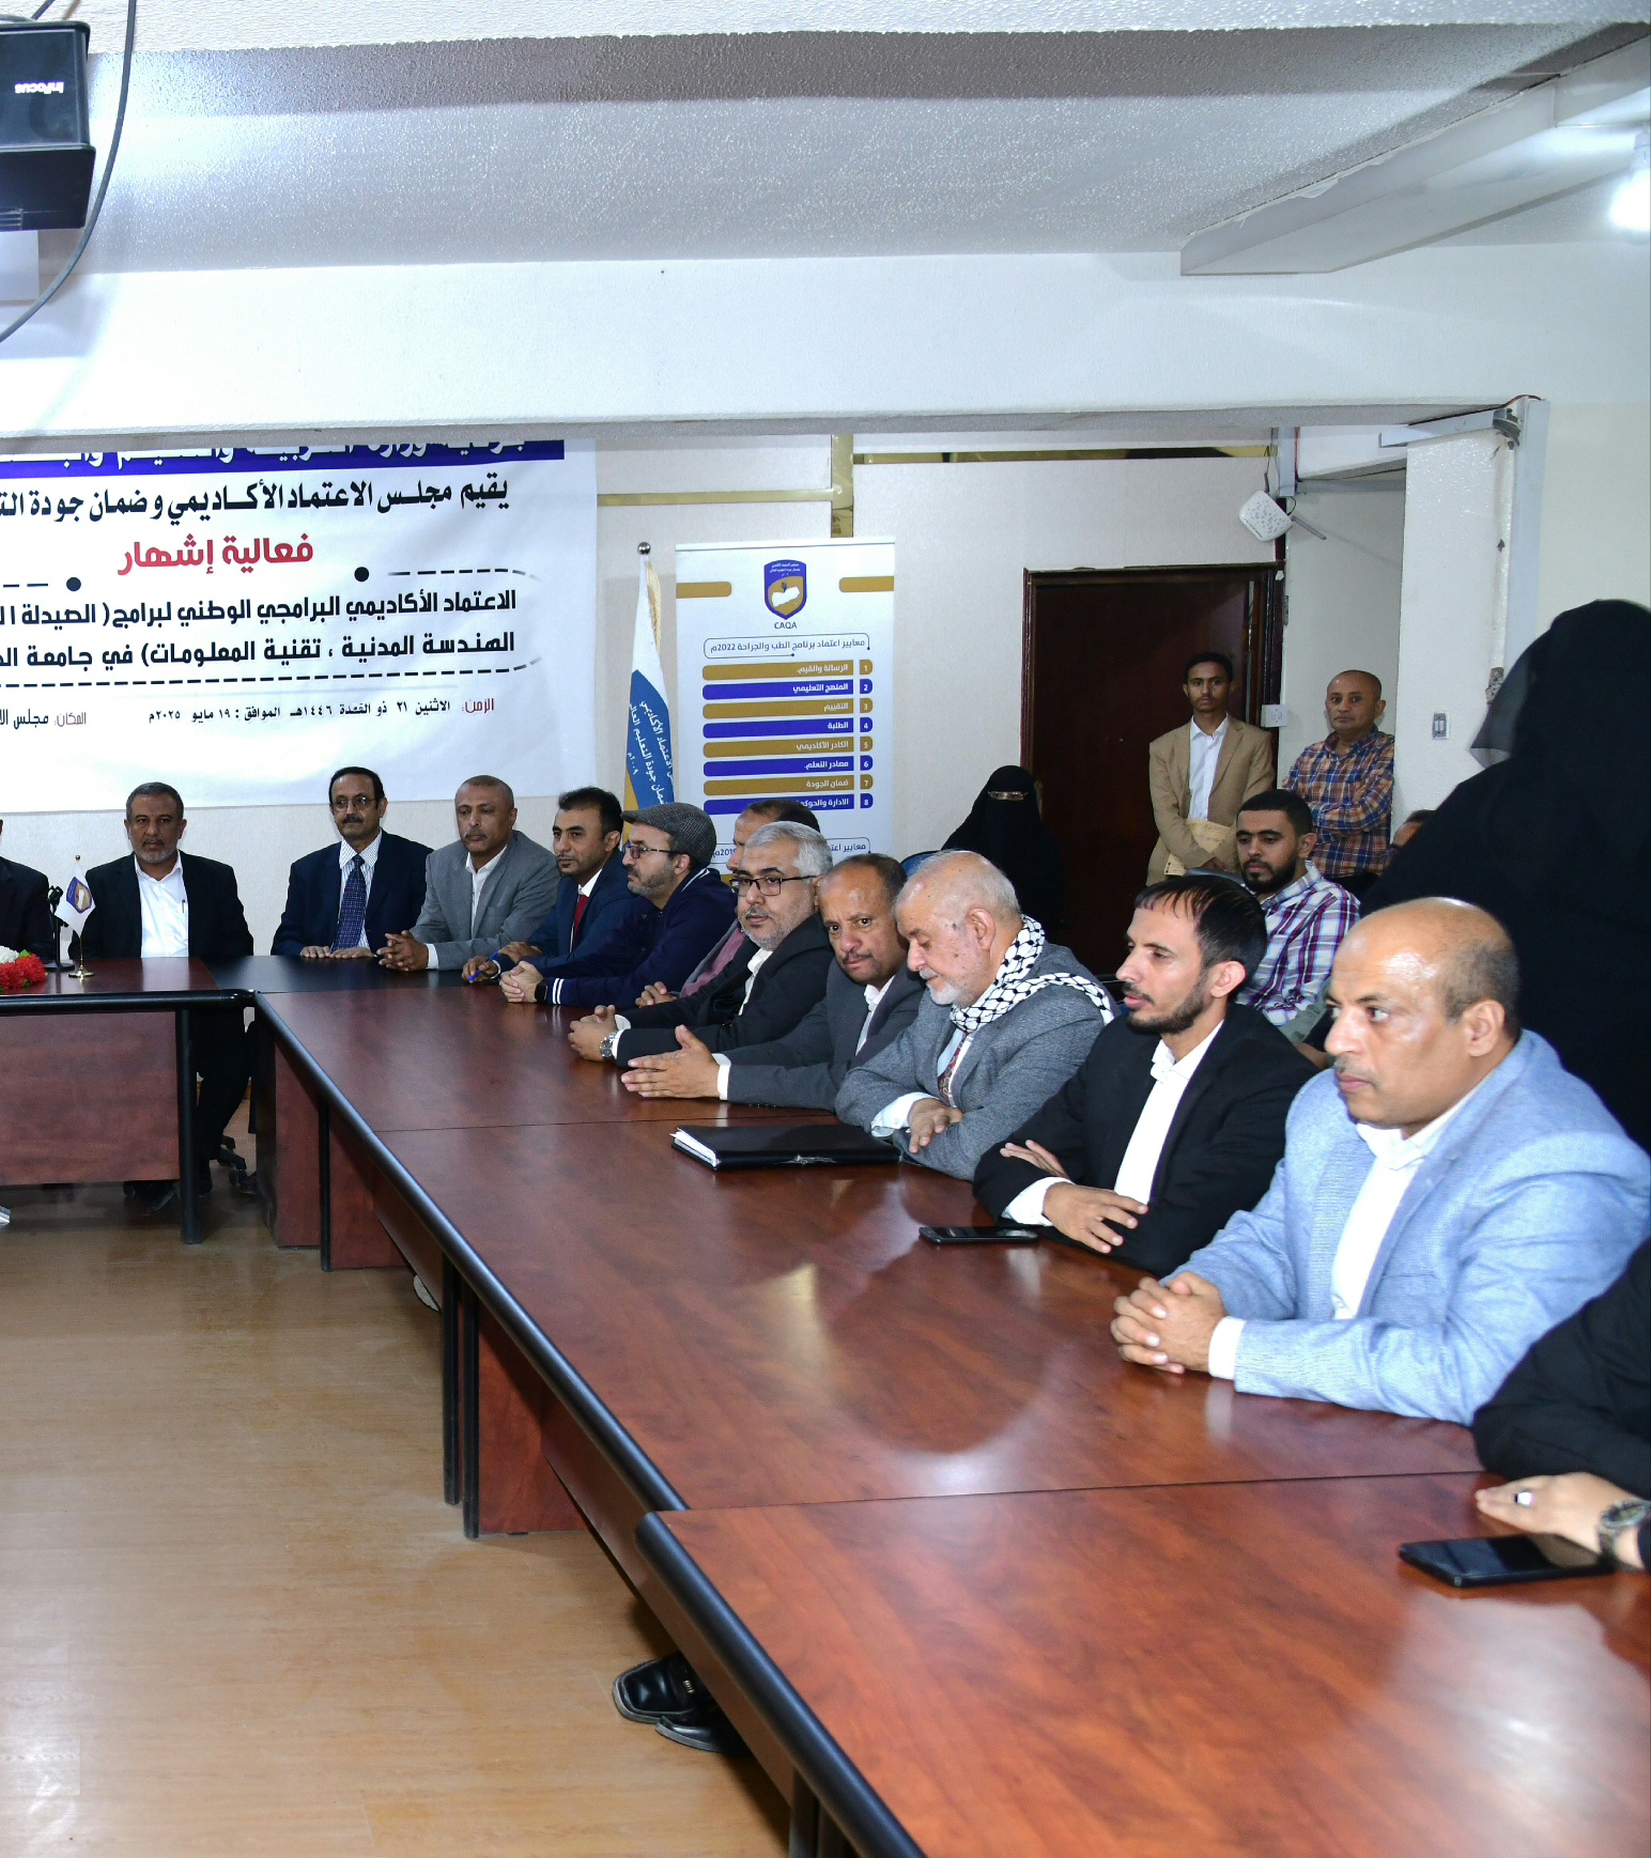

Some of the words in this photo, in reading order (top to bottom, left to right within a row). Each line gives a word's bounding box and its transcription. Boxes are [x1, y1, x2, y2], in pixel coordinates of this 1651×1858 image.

[14, 81, 64, 94] InFocus
[287, 480, 373, 510] الاعتماد
[377, 479, 453, 514] مجلس
[460, 472, 510, 510] يقيم
[29, 489, 84, 523] جودة
[167, 477, 284, 527] الأكاديمي
[117, 532, 214, 576] إشهار
[221, 532, 314, 574] فعالية
[257, 594, 341, 625] البرامجي
[345, 588, 438, 622] الأكاديمي
[443, 589, 517, 613] الاعتماد
[21, 602, 97, 631] الصيدلة
[177, 597, 251, 628] الوطني
[774, 621, 798, 630] CAQA
[341, 634, 415, 664] المدنية
[422, 631, 515, 654] الهندسة
[737, 642, 770, 652] والجراحة
[771, 641, 791, 650] الطب
[791, 640, 816, 651] برنامج
[817, 639, 840, 648] اعتماد
[842, 638, 866, 649] معايير
[26, 644, 93, 672] جامعة
[102, 643, 134, 671] في
[263, 637, 321, 667] تقنية
[792, 684, 824, 694] التعليمي
[825, 683, 848, 693] المنهج
[219, 708, 231, 719] ١٩
[376, 700, 388, 717] ذو
[396, 700, 408, 712] ٢١
[415, 699, 451, 715] الاثنين
[13, 708, 50, 730] مجلس
[191, 709, 215, 723] مايو
[827, 721, 848, 731] الطلبة
[830, 740, 848, 750] الكادر
[829, 760, 849, 770] مصادر
[799, 799, 827, 808] والحوك
[842, 842, 867, 853] معايير
